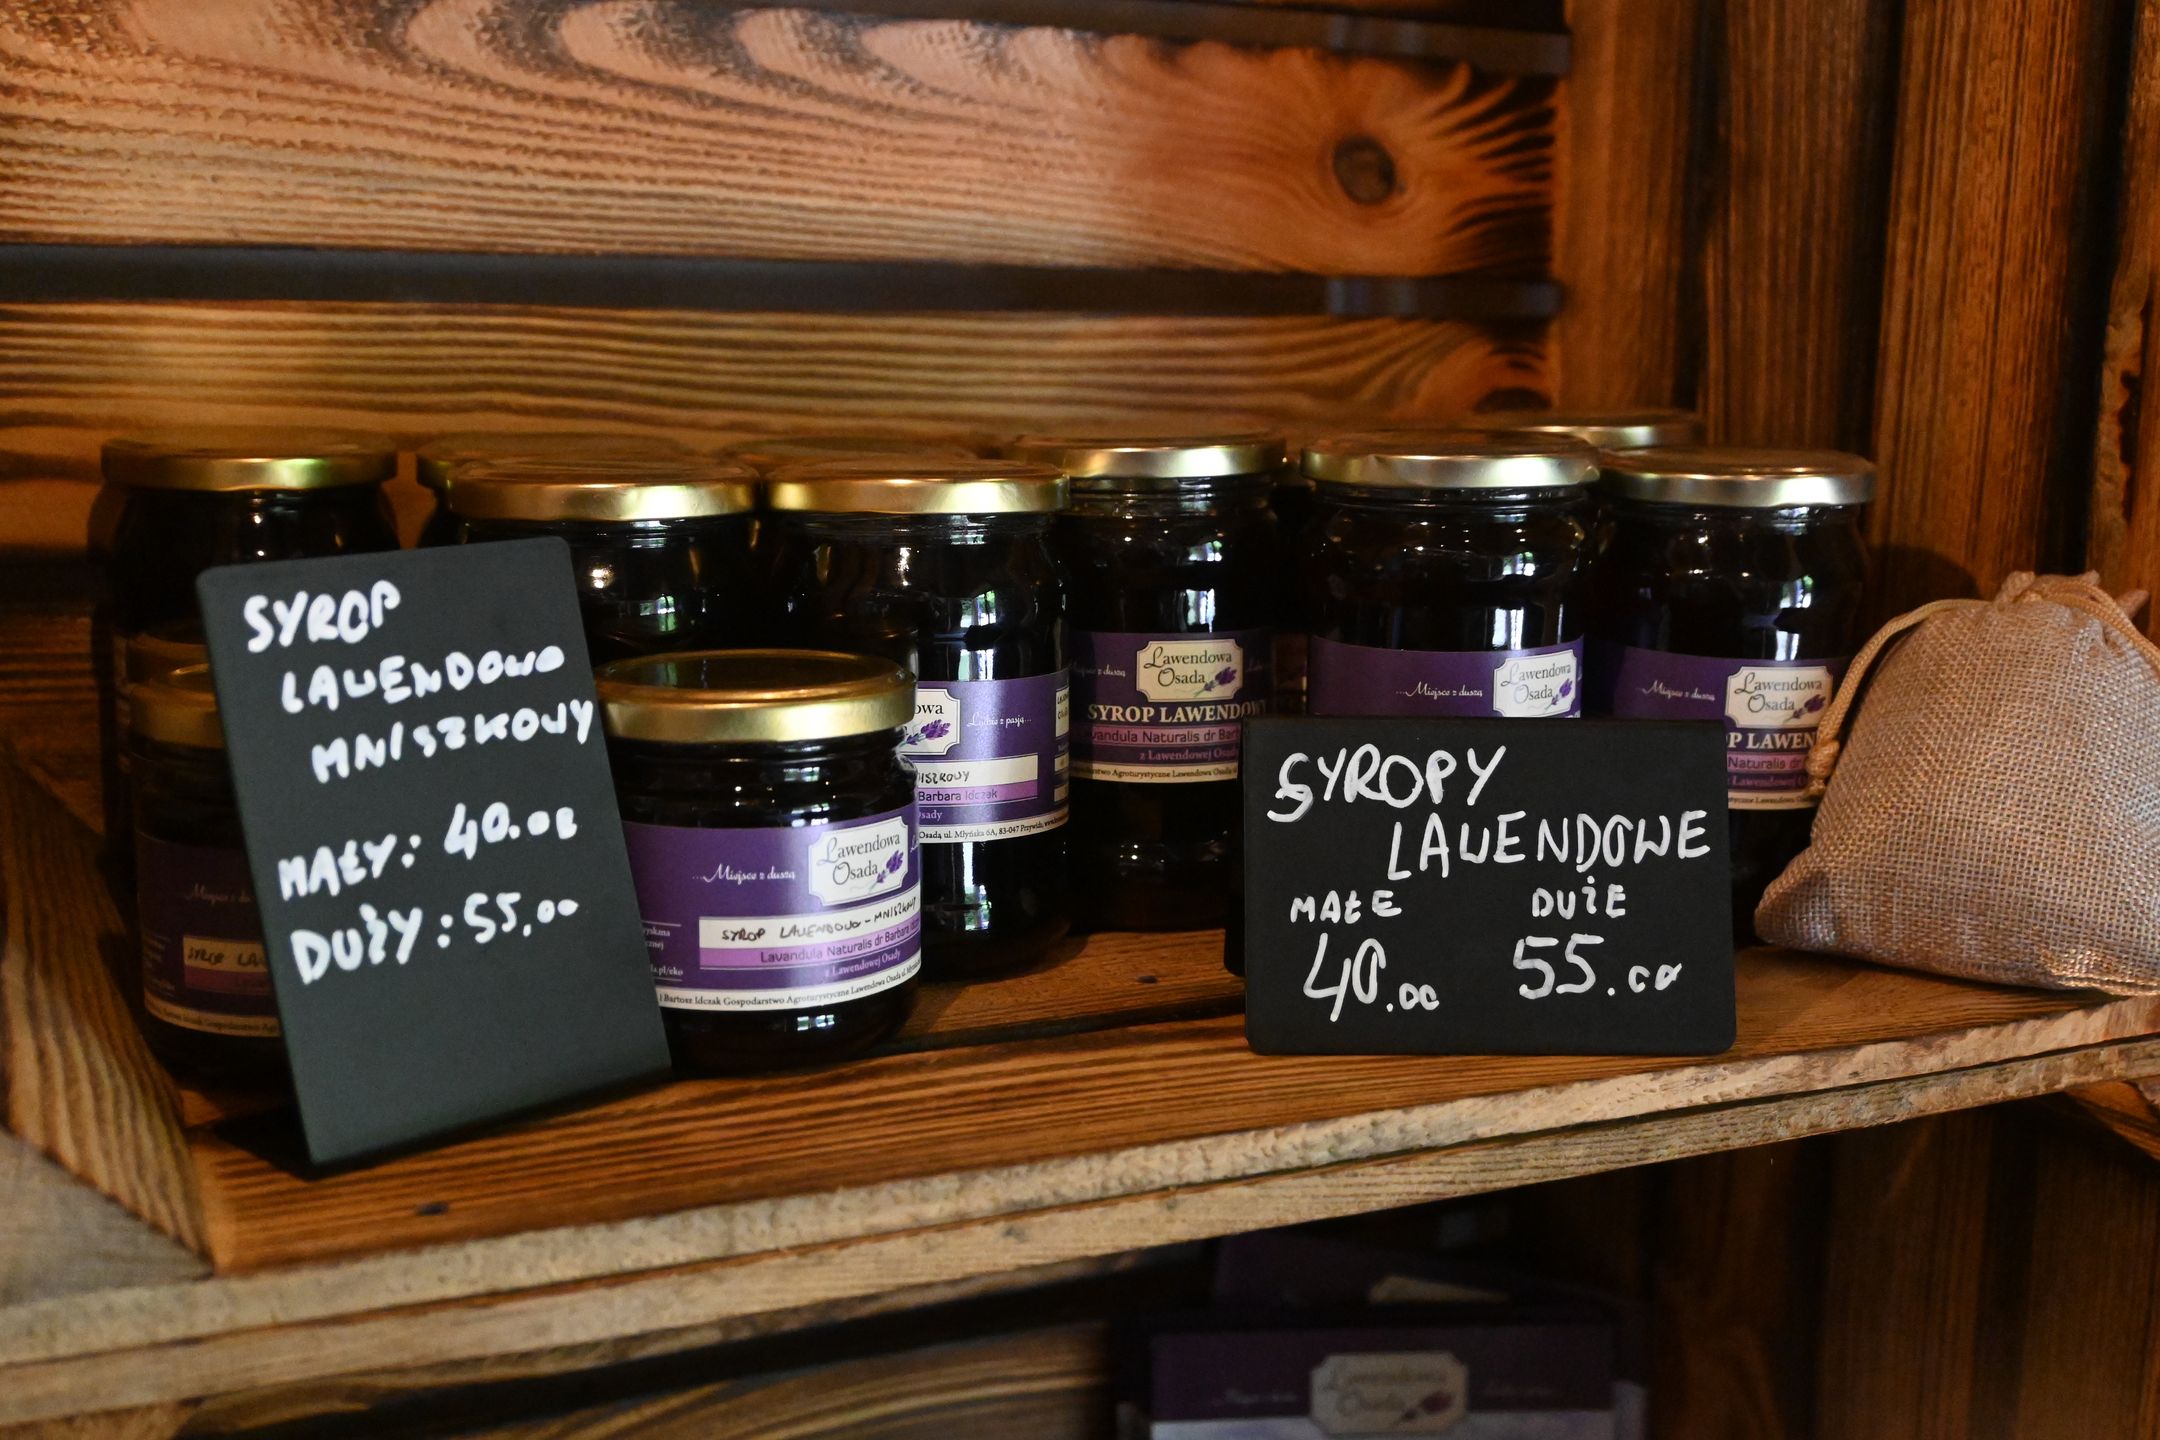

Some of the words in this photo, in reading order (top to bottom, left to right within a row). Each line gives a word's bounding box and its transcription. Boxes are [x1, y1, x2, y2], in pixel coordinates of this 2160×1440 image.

[244, 580, 400, 652] SYROP
[1143, 646, 1232, 669] Lawendowa
[1158, 668, 1205, 687] Osada
[1500, 662, 1571, 687] Lawendowa
[1734, 672, 1822, 695] Lawendowa
[1514, 683, 1553, 705] Osada
[1748, 694, 1795, 713] Osada
[1088, 704, 1155, 723] SYROP
[1142, 730, 1199, 744] Naturalis
[1204, 730, 1214, 742] dr
[917, 770, 970, 785] ISZKOWY
[1267, 744, 1506, 822] SYROPY
[918, 791, 961, 802] Barbara
[999, 825, 1020, 836] 83-047
[816, 833, 901, 866] Lawendowa
[767, 866, 796, 881] duszą
[832, 860, 879, 886] Osada
[722, 928, 766, 942] SYROP
[761, 947, 822, 964] Lavandula
[827, 939, 872, 956] Naturalis
[875, 936, 884, 948] dr
[832, 954, 881, 976] Lawendowej
[1303, 933, 1440, 1022] 40.00
[695, 996, 721, 1005] Idczak
[723, 996, 785, 1007] Gospodarstwo
